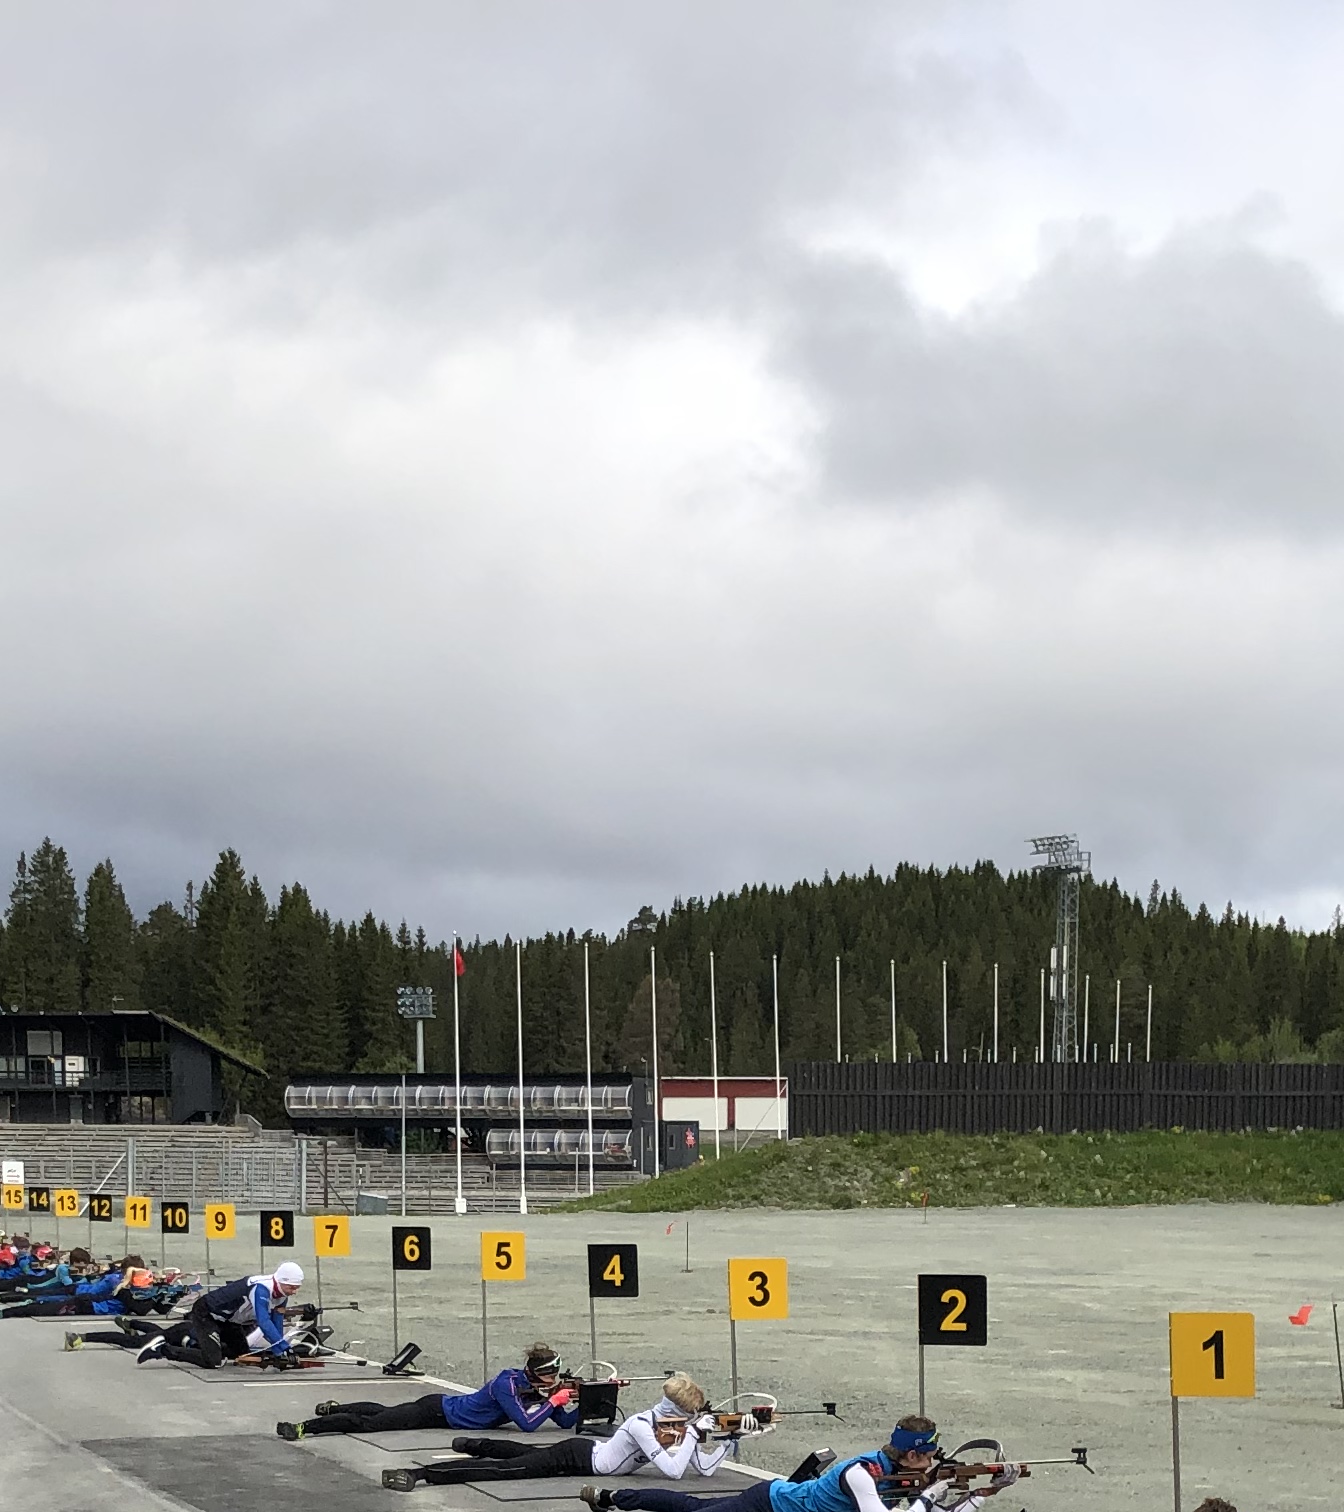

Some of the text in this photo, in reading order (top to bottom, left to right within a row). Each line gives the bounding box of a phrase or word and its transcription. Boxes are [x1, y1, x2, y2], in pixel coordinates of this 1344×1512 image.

[6, 1189, 22, 1203] 15
[31, 1191, 48, 1206] 14
[57, 1196, 76, 1211] 13
[91, 1200, 110, 1216] 12
[130, 1204, 147, 1220] 11
[164, 1208, 186, 1227] 10
[215, 1211, 226, 1231] 9
[270, 1218, 284, 1240] 8
[325, 1225, 338, 1248] 7
[403, 1235, 419, 1261] 6
[496, 1242, 512, 1270] 5
[603, 1255, 625, 1287] 4
[748, 1271, 770, 1306] 3
[940, 1289, 967, 1331] 2
[1202, 1330, 1224, 1380] 1
